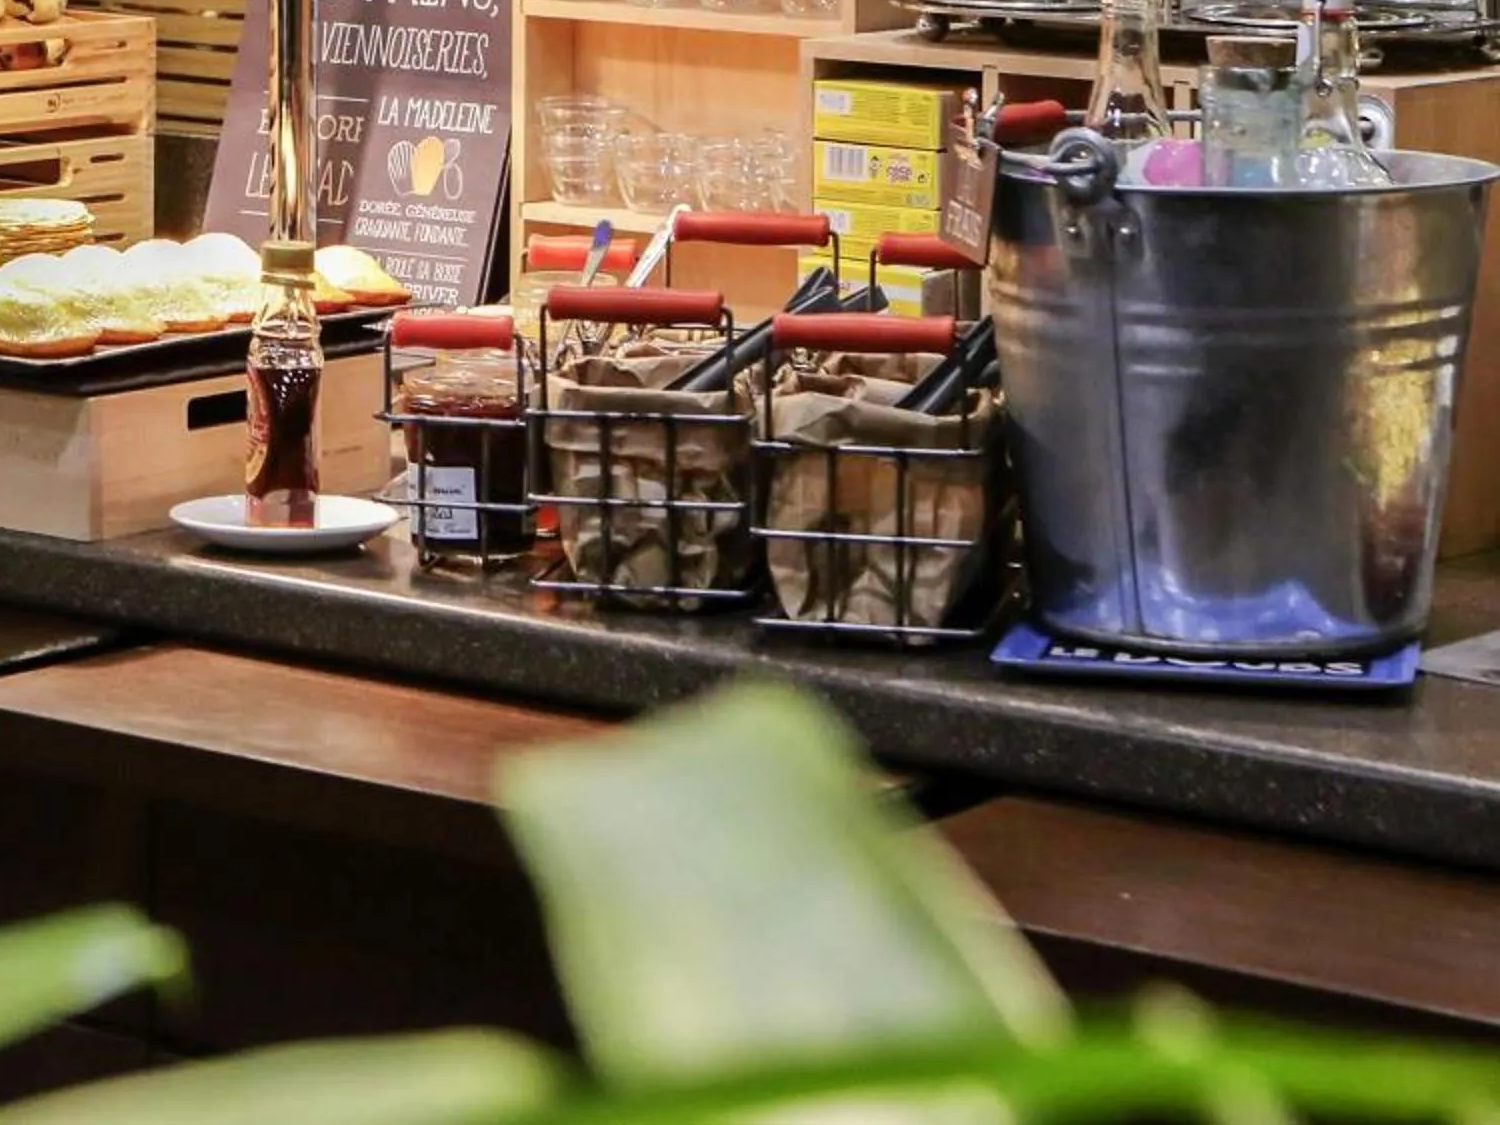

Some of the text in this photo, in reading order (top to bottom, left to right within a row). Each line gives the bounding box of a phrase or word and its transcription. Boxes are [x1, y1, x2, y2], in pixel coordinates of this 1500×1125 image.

[320, 21, 490, 80] VIENNOISERIES,
[377, 95, 499, 135] LA MADELEINE
